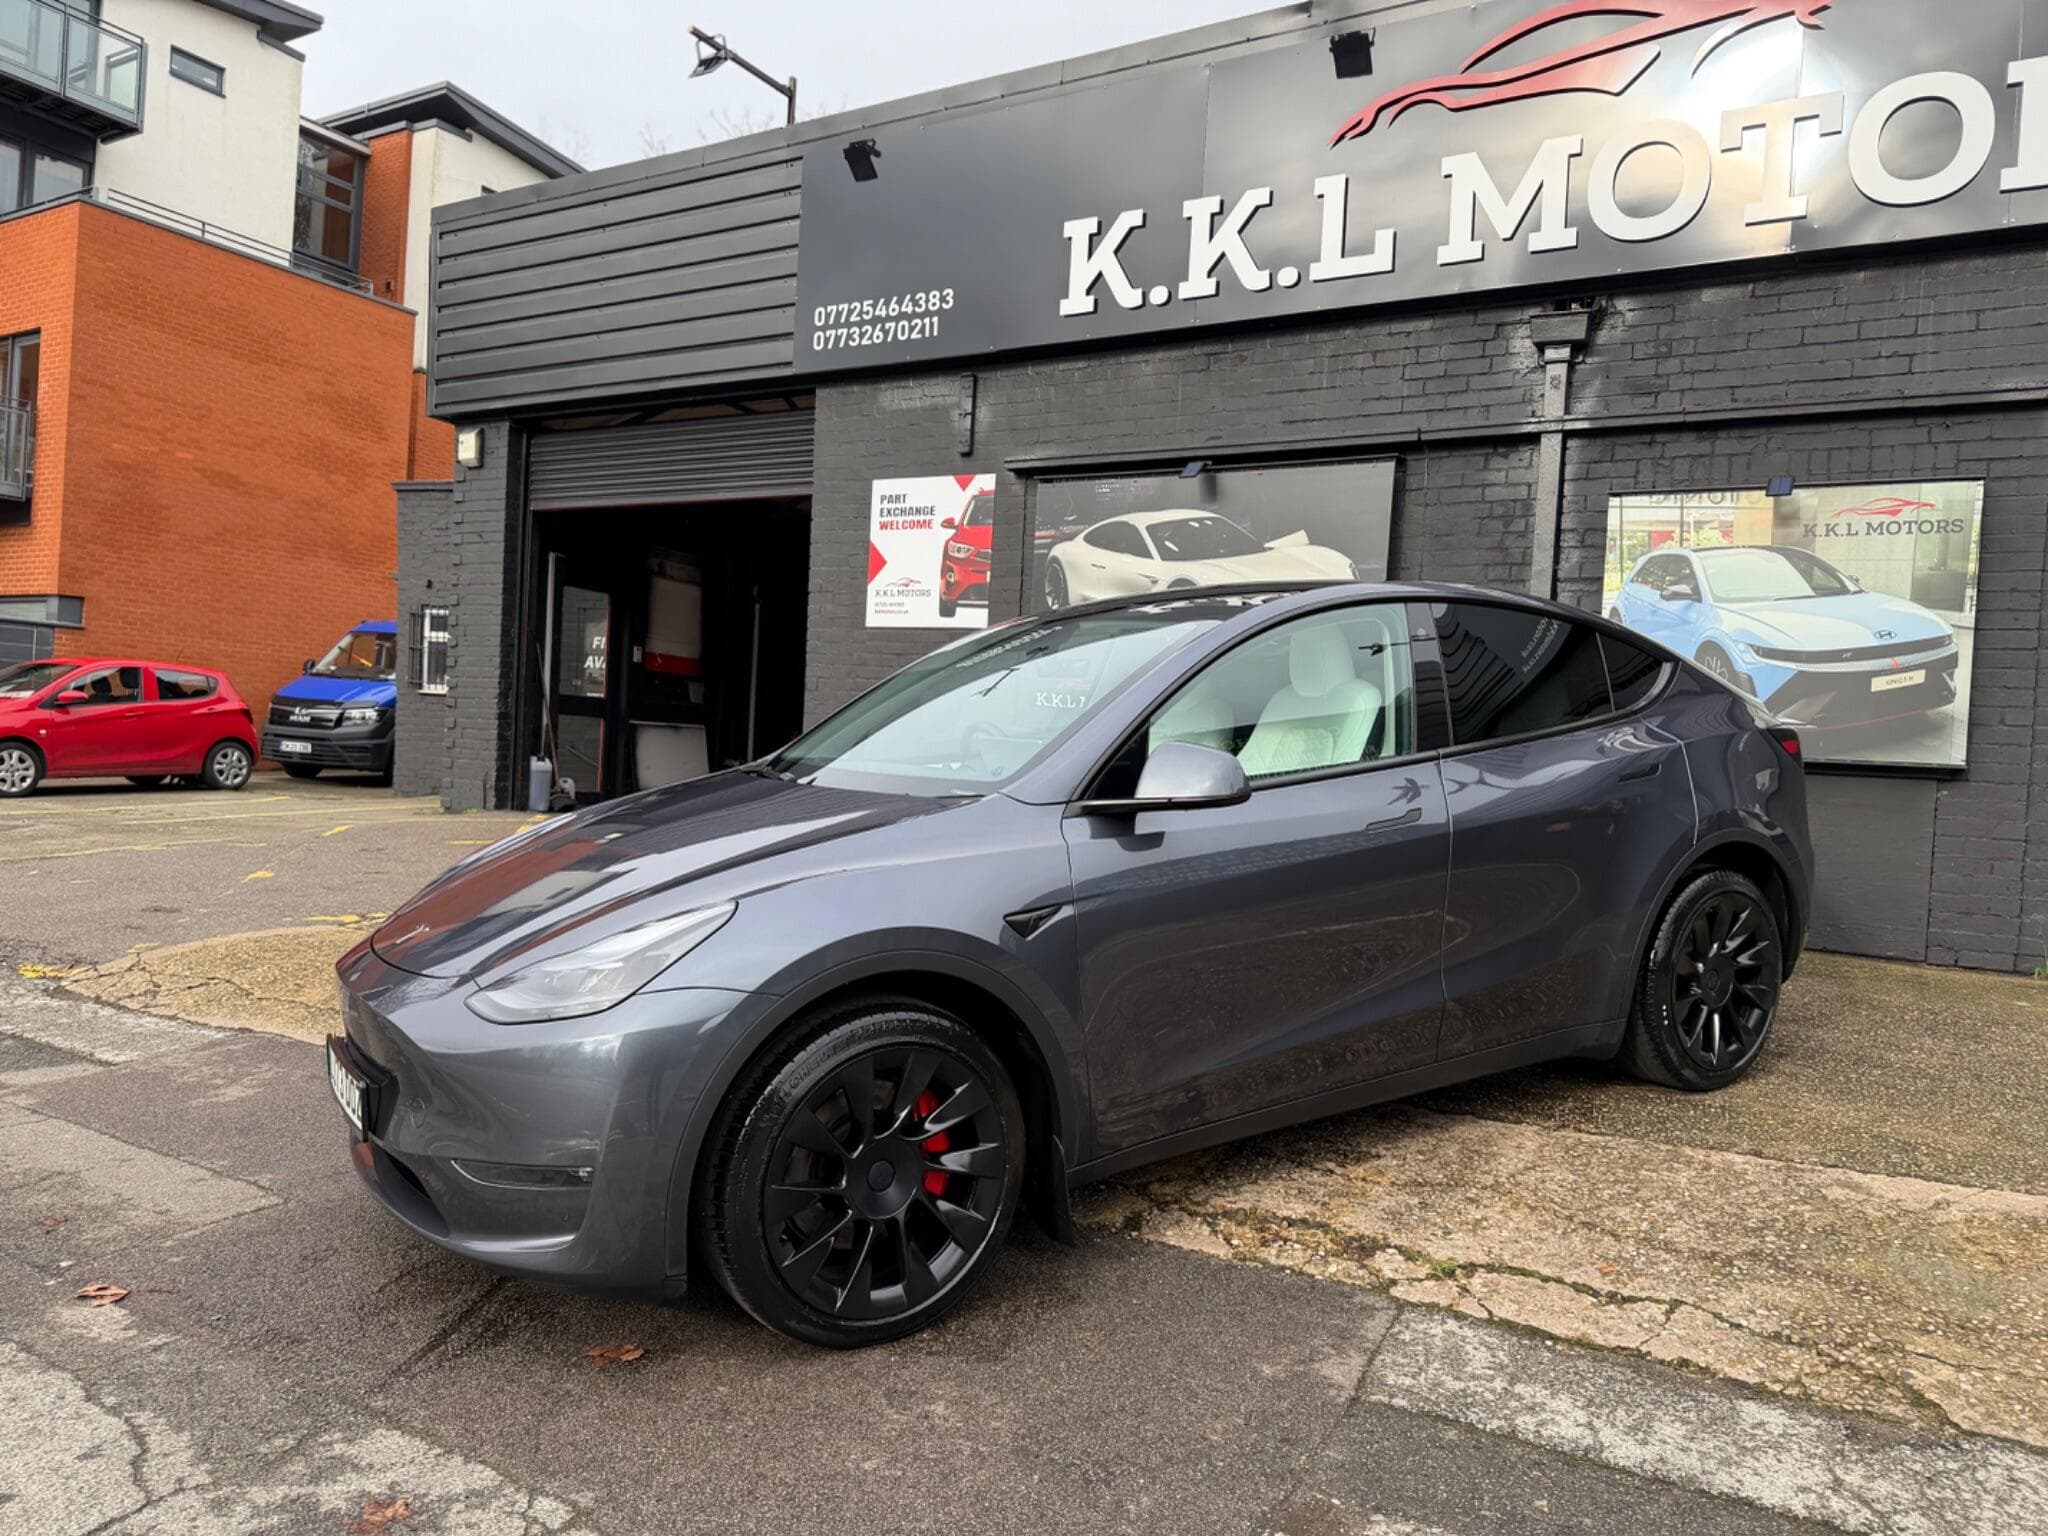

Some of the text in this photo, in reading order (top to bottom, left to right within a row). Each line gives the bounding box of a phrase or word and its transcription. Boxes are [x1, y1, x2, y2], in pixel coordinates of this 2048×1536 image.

[1059, 173, 1395, 317] K.K.L
[814, 288, 954, 326] 07725464383
[813, 316, 939, 350] 07732670211
[880, 493, 907, 504] PART
[880, 505, 936, 517] EXCHANGE
[879, 518, 934, 530] WELCOME
[1803, 518, 1964, 538] K.K.L MOTORS
[897, 588, 932, 598] MOTORS
